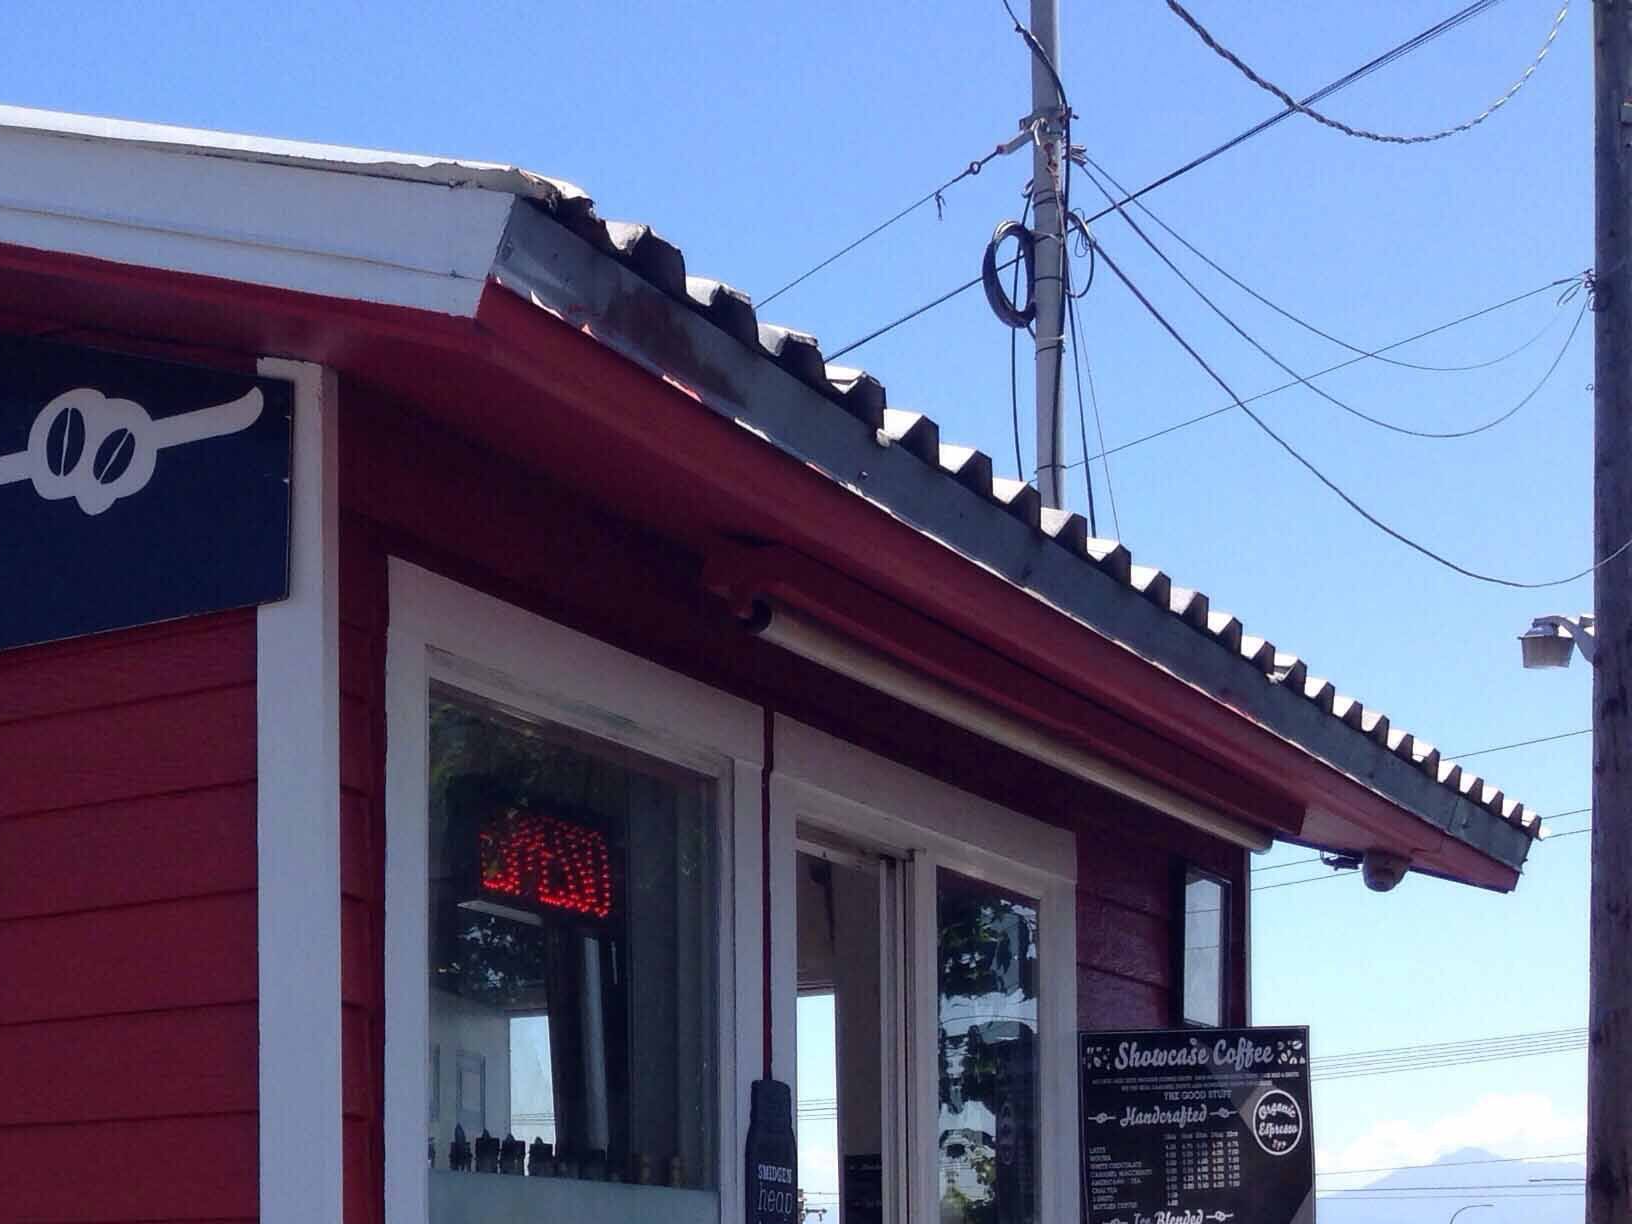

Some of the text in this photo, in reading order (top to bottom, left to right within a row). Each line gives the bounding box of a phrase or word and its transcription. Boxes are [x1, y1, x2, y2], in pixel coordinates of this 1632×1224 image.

[1114, 1037, 1274, 1071] Showcase Coffee
[1182, 1090, 1206, 1100] GOOD
[1120, 1103, 1207, 1128] Handcrafted
[1258, 1102, 1296, 1120] Organic
[1258, 1121, 1298, 1138] Espresso
